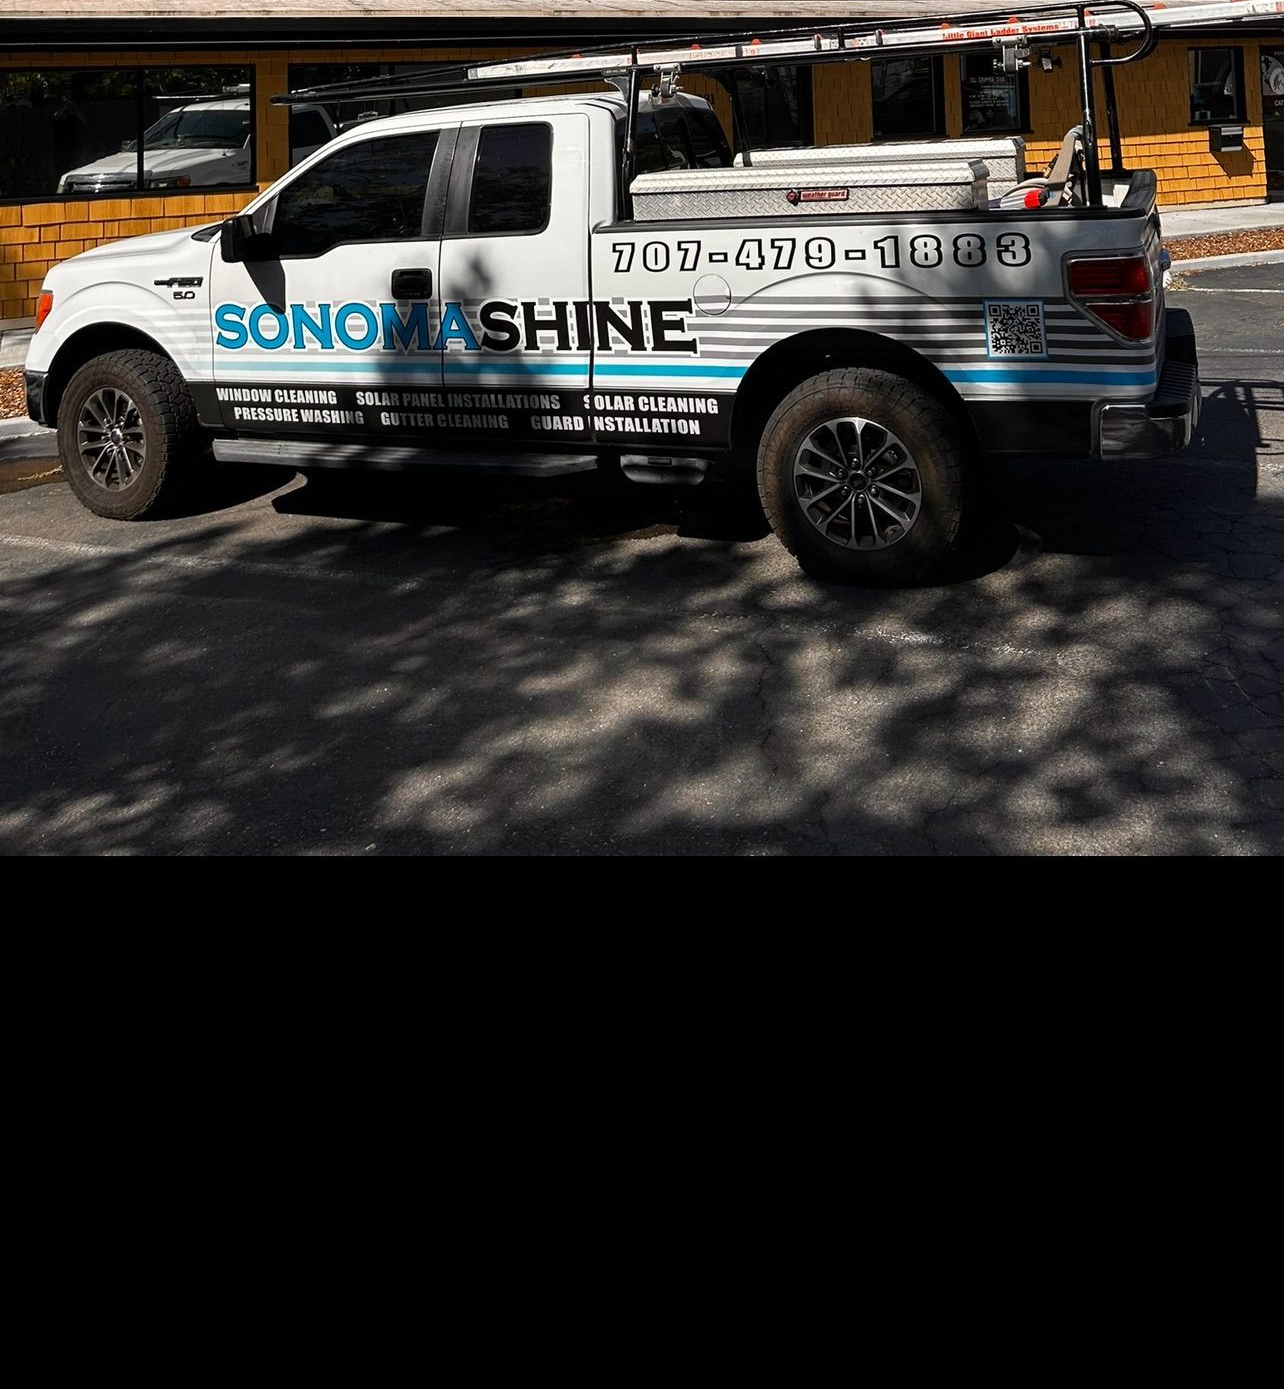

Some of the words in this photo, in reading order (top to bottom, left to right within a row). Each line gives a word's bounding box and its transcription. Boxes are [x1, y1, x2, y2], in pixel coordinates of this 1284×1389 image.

[942, 31, 964, 40] Little
[966, 29, 989, 39] Giant
[991, 27, 1020, 37] Ladder
[1021, 24, 1060, 34] Systems
[828, 190, 846, 199] guard
[611, 232, 1032, 274] 707-479-1883
[215, 387, 272, 403] WINDOW
[274, 388, 338, 405] CLEANING
[355, 391, 400, 407] SOLAR
[402, 393, 445, 408] PANEL
[449, 394, 561, 410] INSTALLATIONS
[583, 394, 635, 411] SOLAR
[638, 396, 719, 414] CLEANING
[233, 407, 299, 422] PRESSURE
[301, 408, 364, 425] WASHING
[380, 411, 434, 427] GUTTER
[436, 412, 509, 429] CLEANING
[530, 415, 584, 431] GUARD
[587, 416, 701, 435] INSTALLATION
